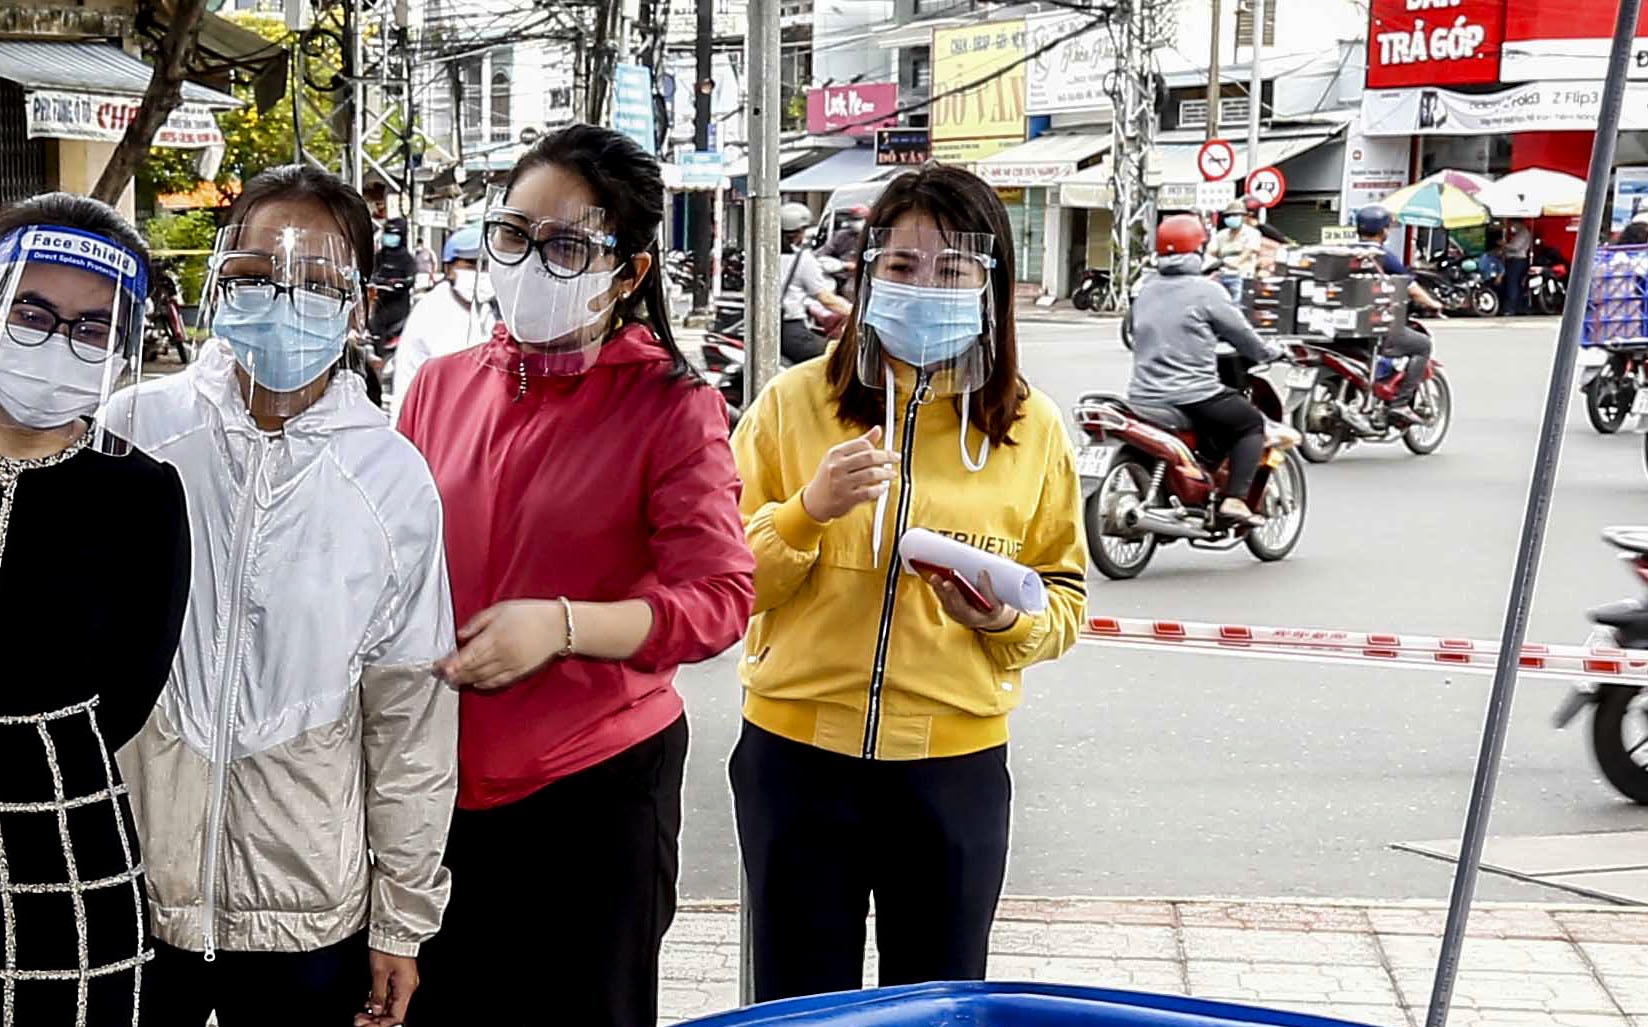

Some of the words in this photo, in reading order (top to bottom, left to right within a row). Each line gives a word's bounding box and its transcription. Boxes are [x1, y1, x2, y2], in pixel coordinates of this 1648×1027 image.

[1565, 91, 1599, 108] Flip3
[32, 233, 72, 249] Face
[79, 240, 131, 270] Shield
[33, 251, 58, 261] Direct
